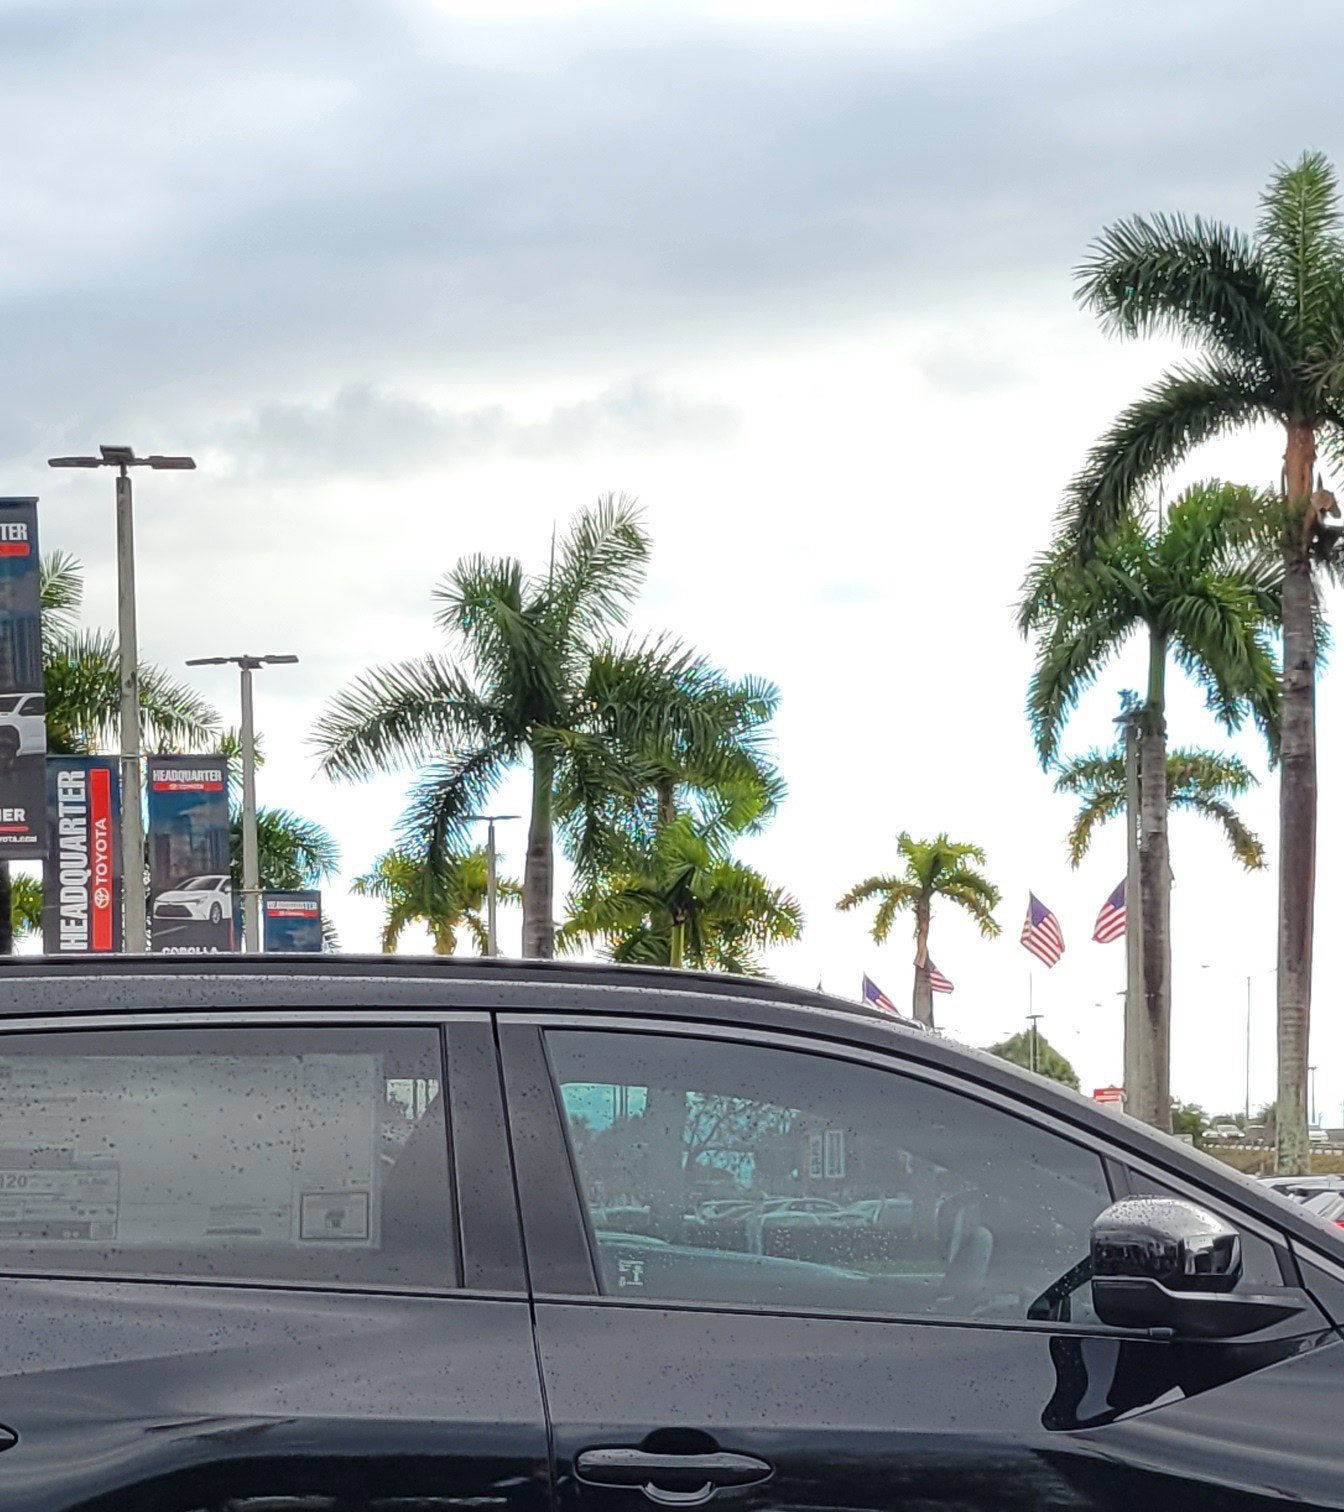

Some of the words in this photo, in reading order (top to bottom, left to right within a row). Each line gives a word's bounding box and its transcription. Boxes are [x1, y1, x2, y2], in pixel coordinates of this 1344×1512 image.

[152, 769, 223, 783] HEADQUARTER
[58, 770, 92, 950] HEADQUARTER
[94, 817, 108, 886] TOYOTA
